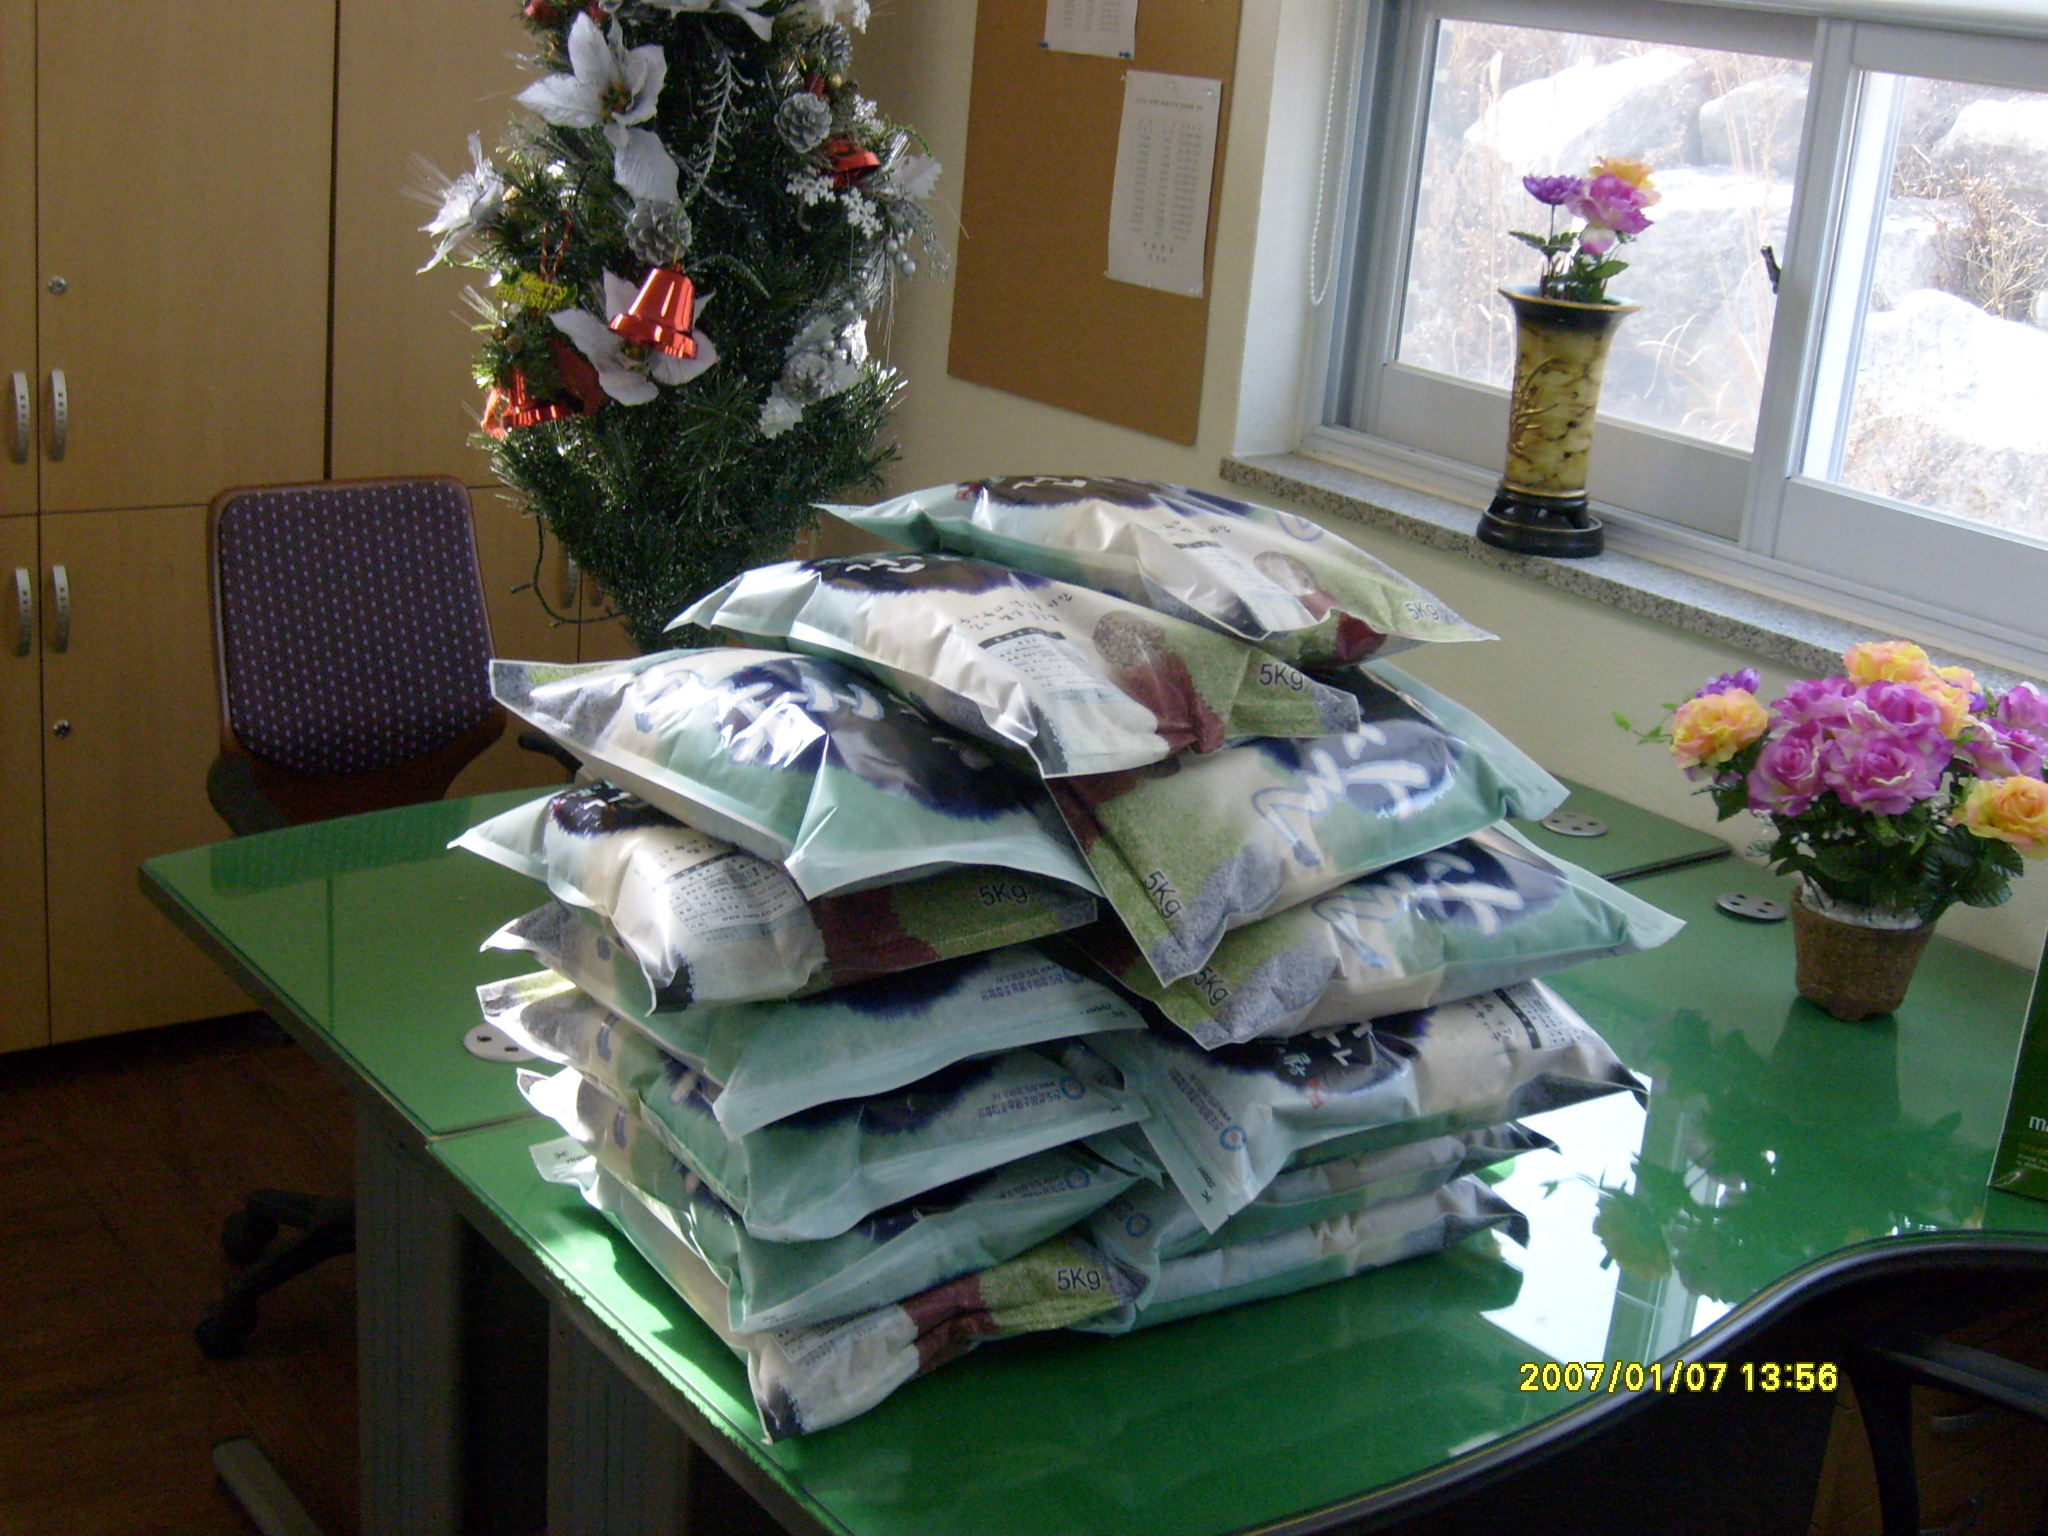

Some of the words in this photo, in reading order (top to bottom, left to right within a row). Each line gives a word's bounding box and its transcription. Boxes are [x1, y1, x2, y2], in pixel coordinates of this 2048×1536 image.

[1404, 601, 1440, 621] 5Kg
[1259, 662, 1304, 692] 5Kg
[979, 883, 1028, 907] 5Kg
[1144, 870, 1182, 919] 5Kg
[1194, 966, 1229, 1006] 5Kg
[1056, 1266, 1102, 1292] 5Kg
